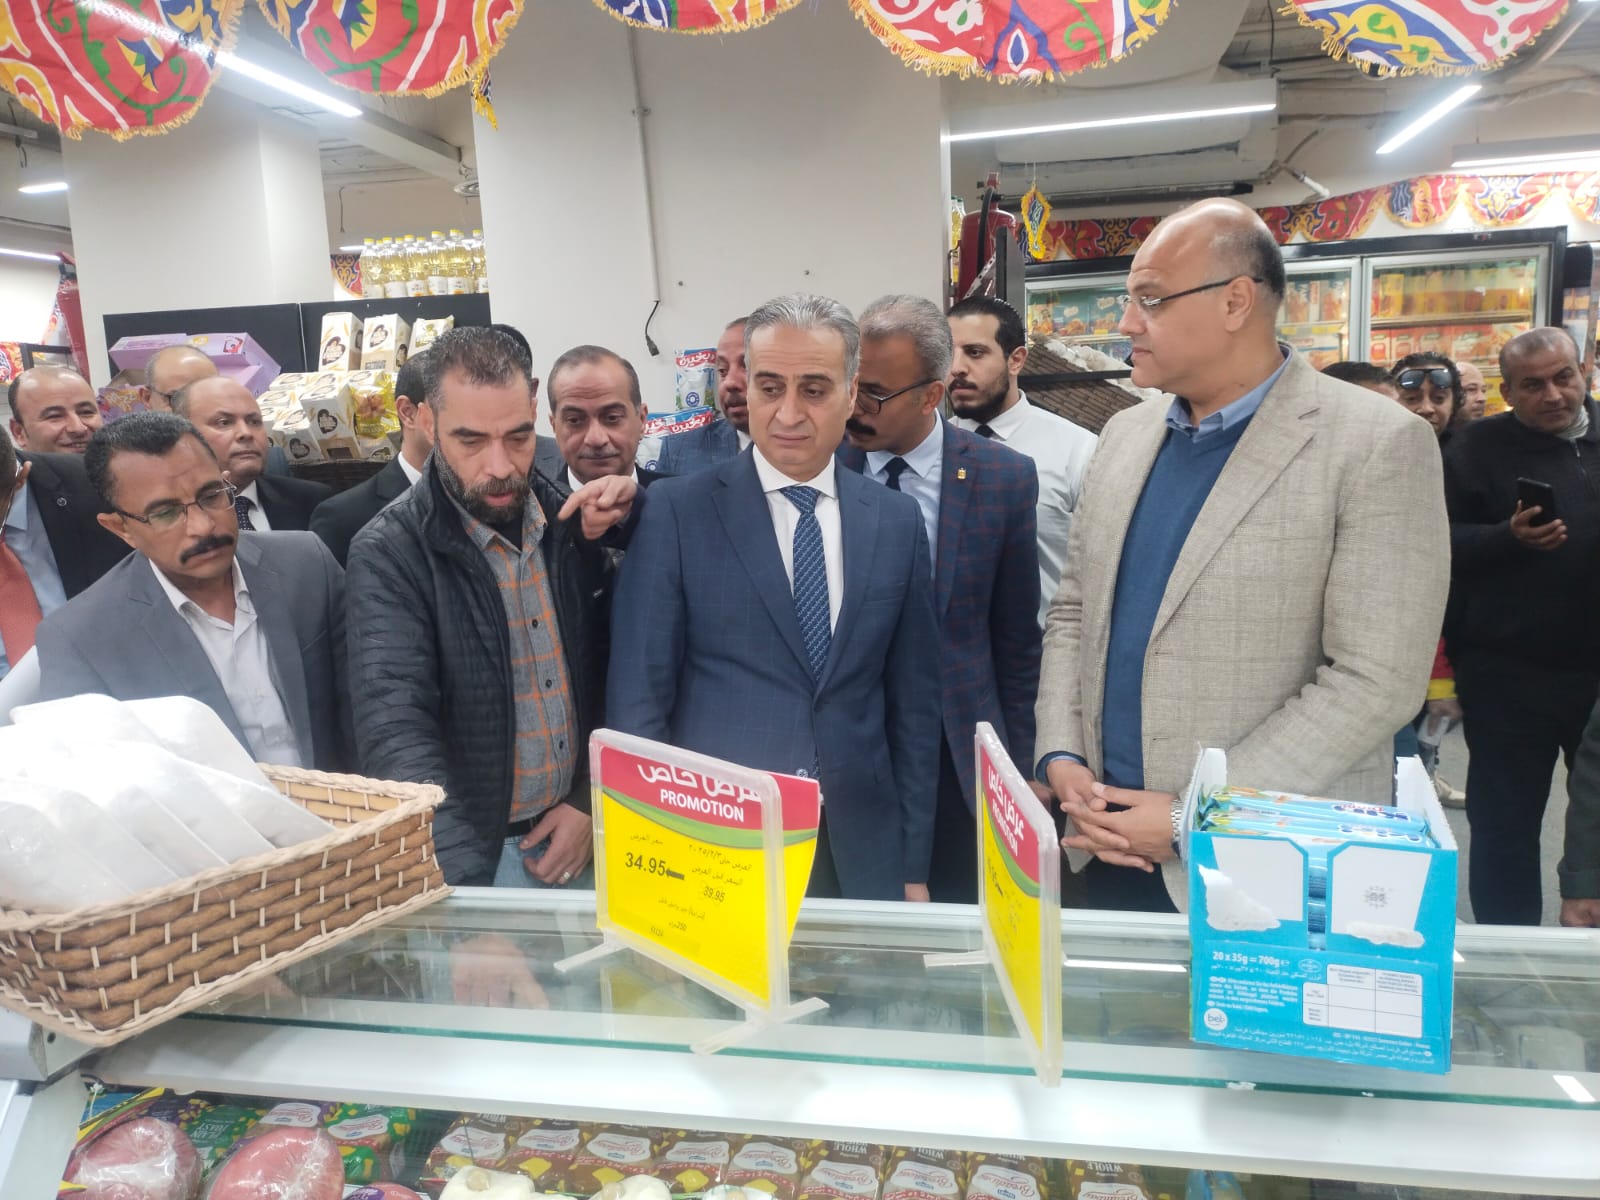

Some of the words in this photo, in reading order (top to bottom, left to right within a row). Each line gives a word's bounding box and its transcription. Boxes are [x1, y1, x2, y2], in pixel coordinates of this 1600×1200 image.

[660, 789, 744, 823] PROMOTION
[1004, 793, 1024, 841] عرض
[992, 798, 1018, 857] PROMOTION
[625, 852, 667, 877] 34.95
[703, 885, 726, 903] 39.95
[1232, 953, 1248, 965] 35g
[1258, 955, 1281, 968] 700g
